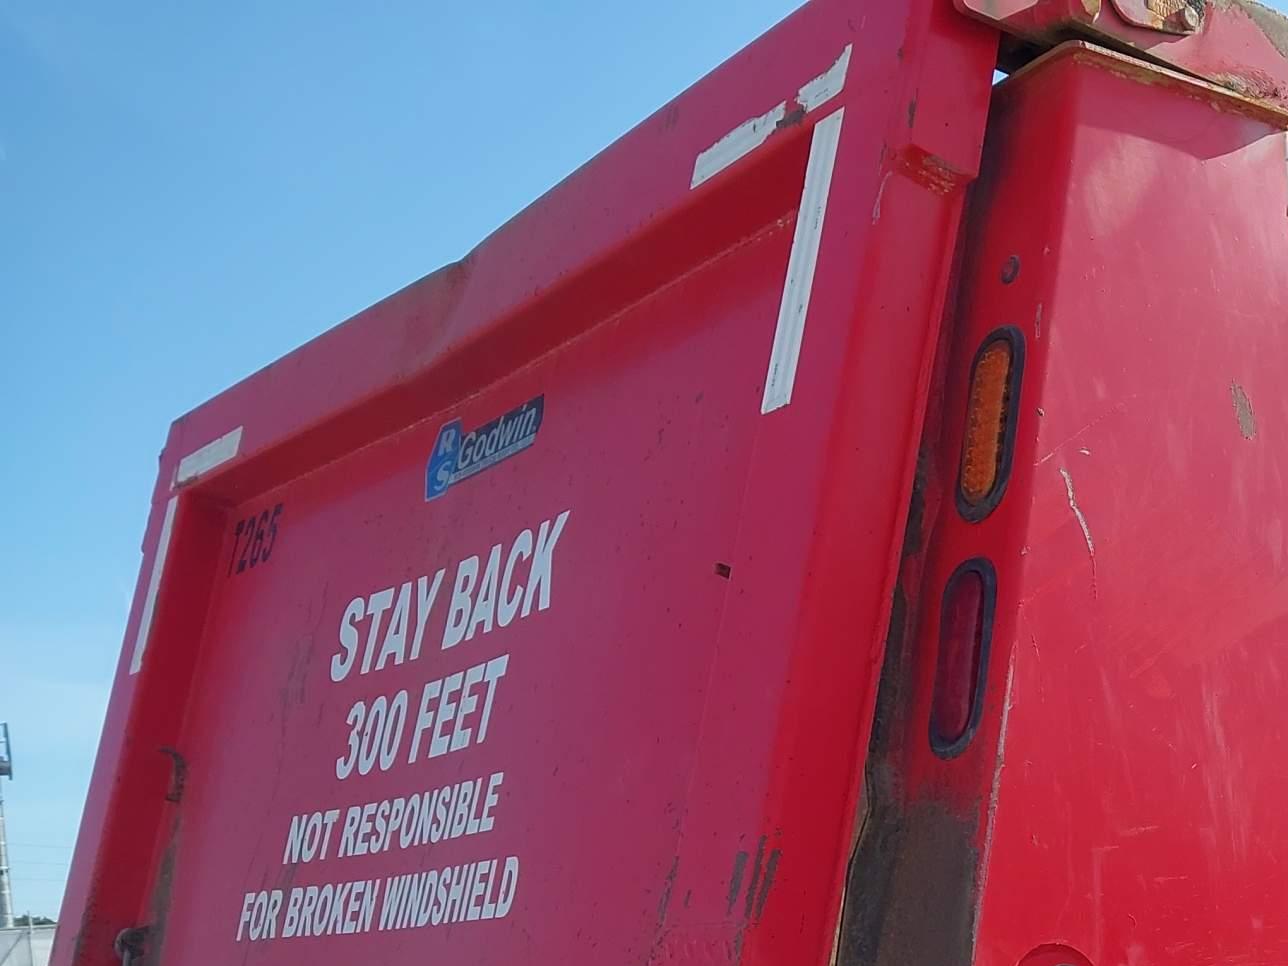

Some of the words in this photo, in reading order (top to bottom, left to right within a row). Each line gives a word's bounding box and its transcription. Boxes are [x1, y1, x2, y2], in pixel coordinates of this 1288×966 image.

[458, 403, 537, 470] Godwin
[226, 503, 284, 578] T265
[330, 568, 446, 683] STAY
[441, 510, 571, 651] BACK
[336, 688, 409, 780] 300
[407, 653, 510, 765] FEET
[282, 808, 341, 866] NOT
[337, 771, 504, 859] RESPONSIBLE
[236, 888, 284, 942] FOR
[281, 875, 381, 937] BROKEN
[377, 855, 520, 932] WINDSHIELD
